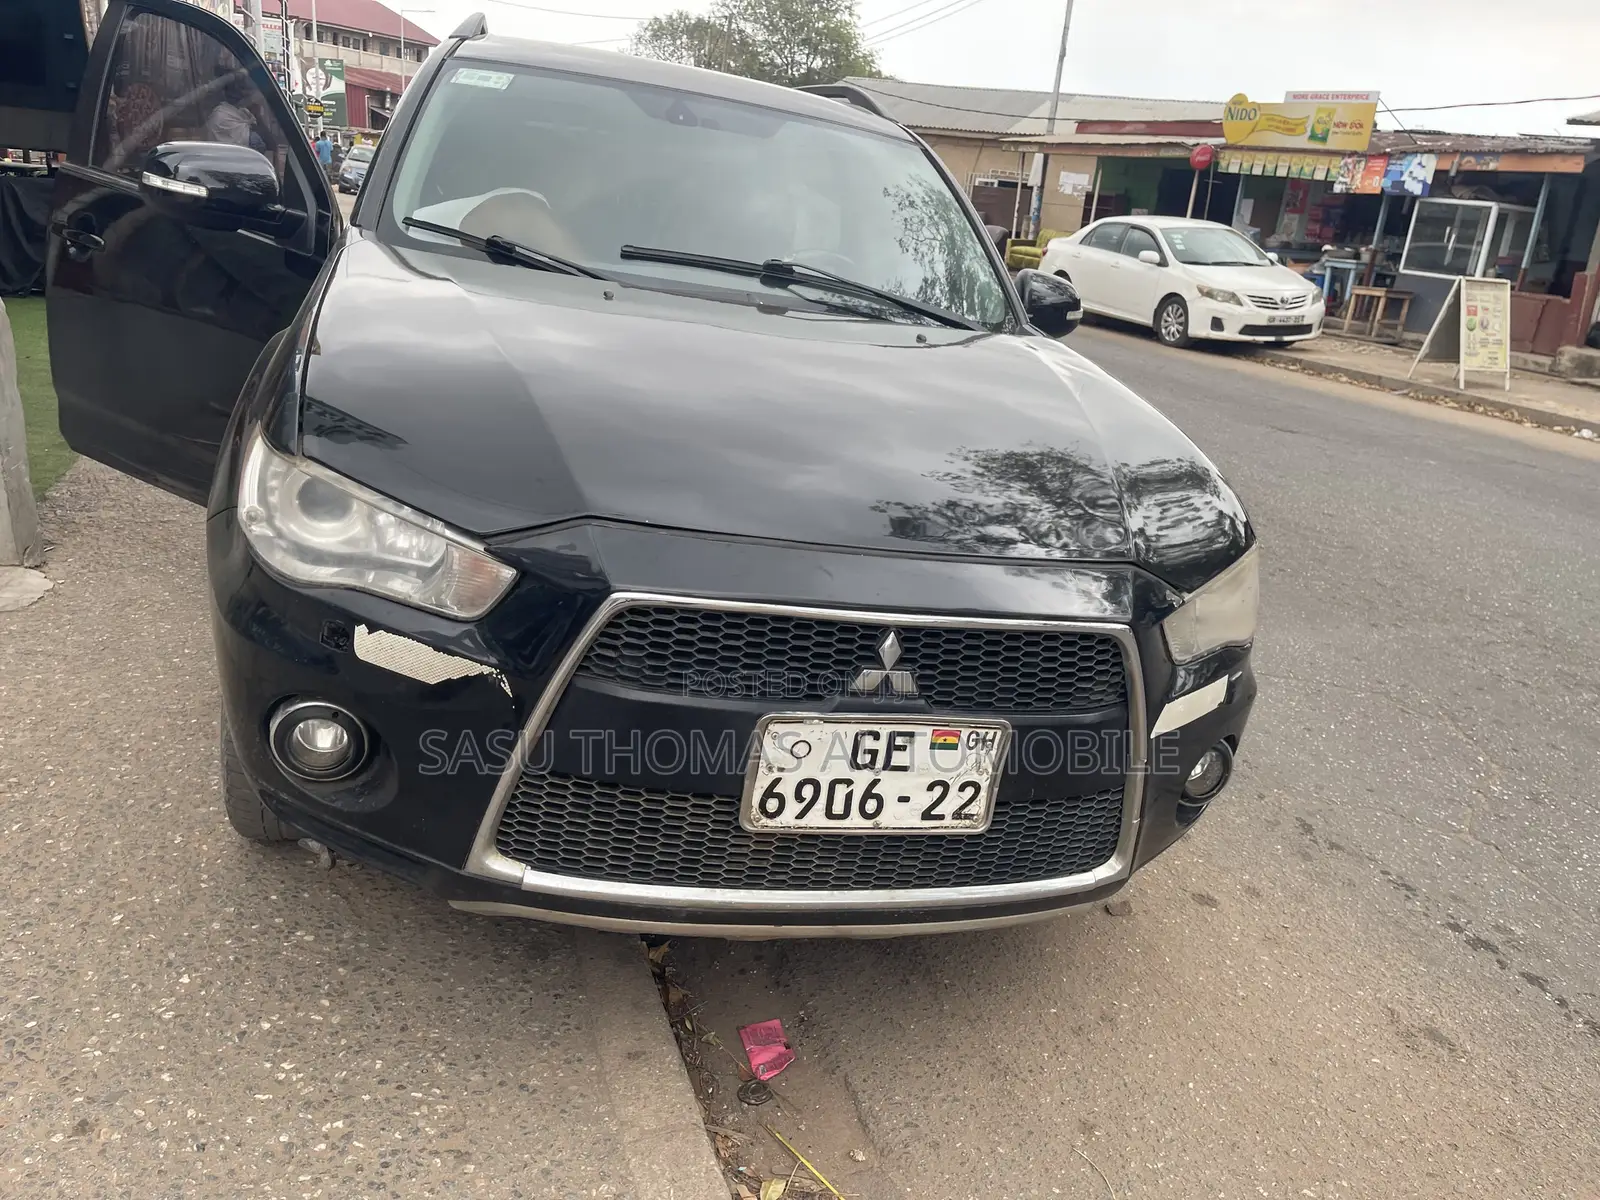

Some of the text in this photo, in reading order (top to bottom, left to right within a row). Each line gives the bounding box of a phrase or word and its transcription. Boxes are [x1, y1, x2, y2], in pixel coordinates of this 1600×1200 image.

[1226, 105, 1257, 120] NIDO
[851, 730, 998, 772] GE GH
